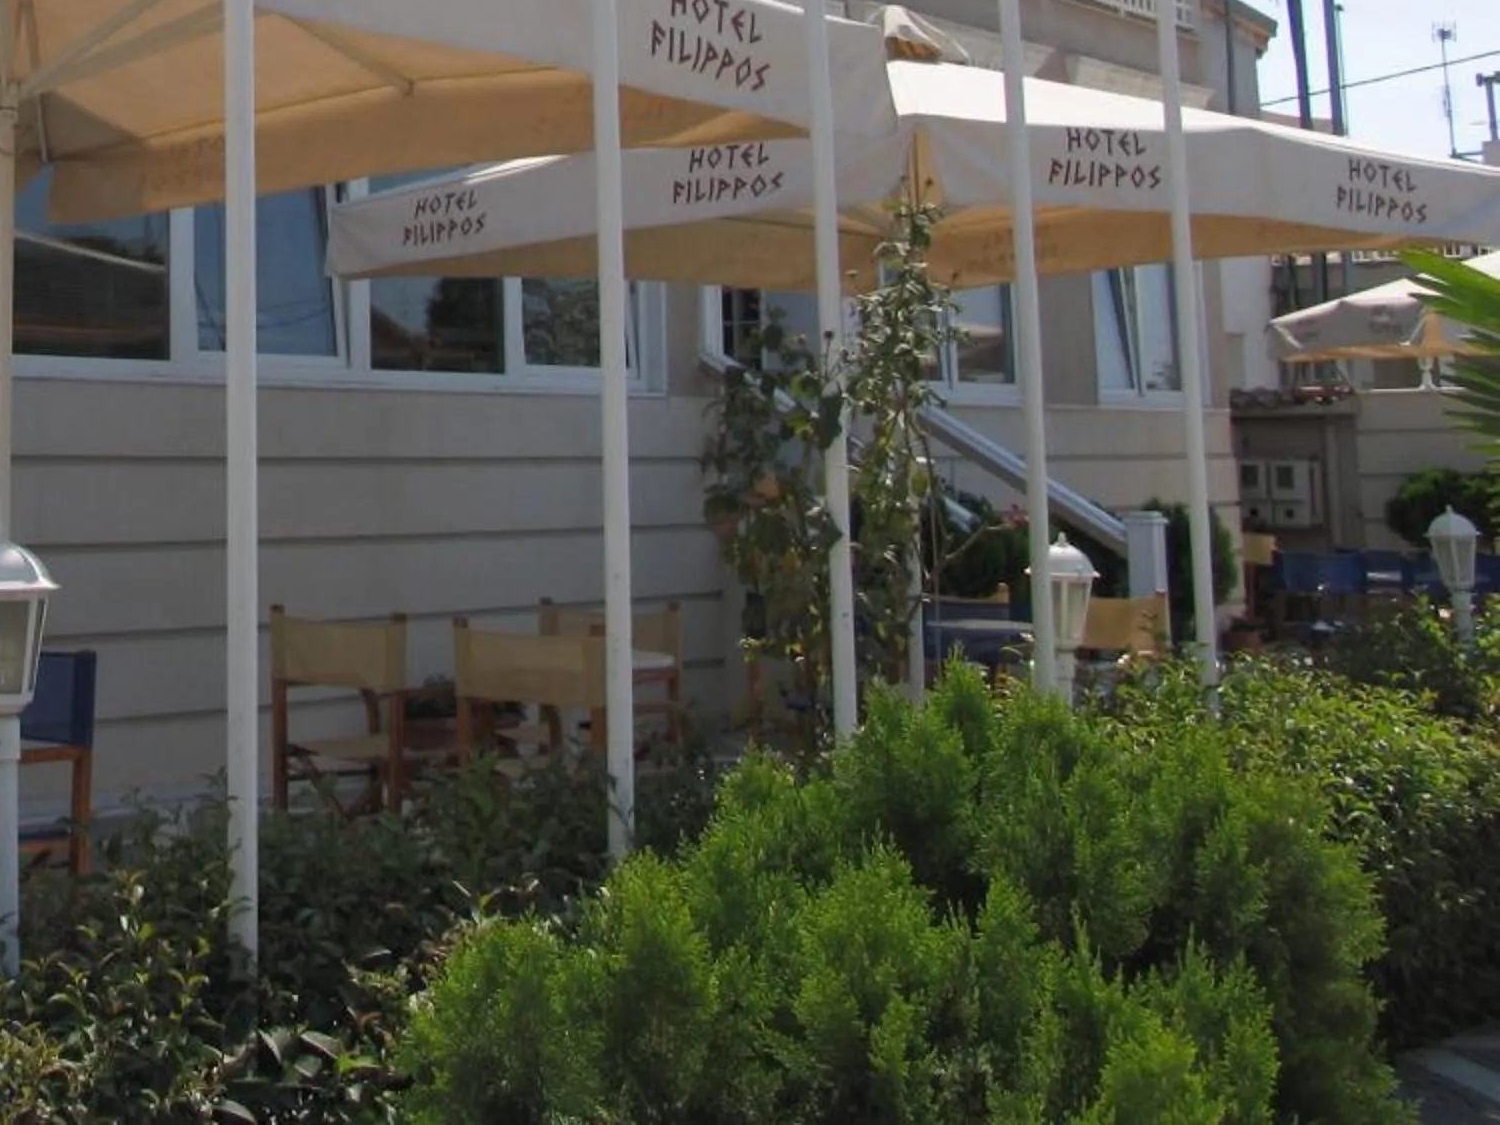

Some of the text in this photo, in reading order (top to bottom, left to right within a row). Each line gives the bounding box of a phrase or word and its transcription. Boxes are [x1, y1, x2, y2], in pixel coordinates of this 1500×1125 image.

[651, 20, 770, 91] FILIPPOS
[1066, 127, 1147, 156] HOTEL
[689, 143, 769, 173] HOTEL
[1049, 158, 1161, 189] FILIPPOS
[673, 172, 784, 204] FILIPPOS
[1348, 157, 1417, 193] HOTEL
[415, 189, 477, 218] HOTEL
[1336, 183, 1428, 224] FILIPPOS
[403, 211, 488, 246] FILIPPOS
